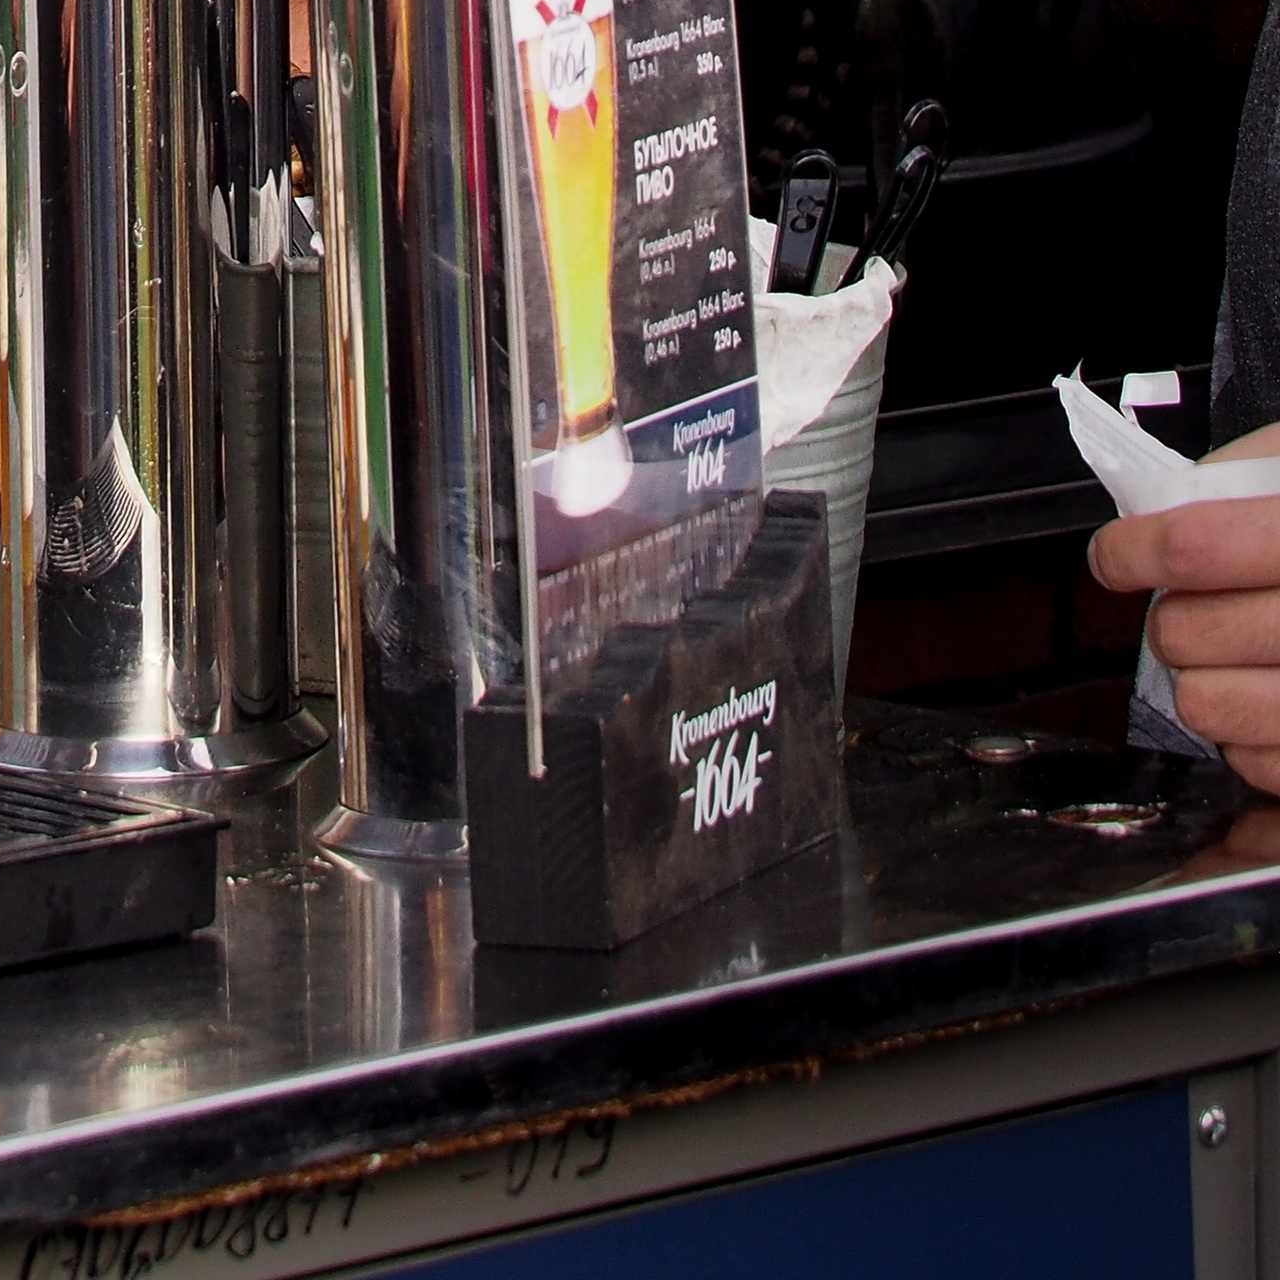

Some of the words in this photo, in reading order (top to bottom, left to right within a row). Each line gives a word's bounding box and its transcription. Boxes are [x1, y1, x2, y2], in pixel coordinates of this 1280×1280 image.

[625, 29, 680, 60] Kronenbourg
[680, 19, 702, 44] 1664
[702, 13, 725, 38] Blanc
[696, 51, 713, 76] 350
[633, 115, 718, 172] БУТЫЛОЧНОЕ
[636, 165, 674, 206] ПИВО
[638, 228, 693, 259] Kronenbourg
[693, 212, 716, 240] 1664
[709, 246, 727, 272] 250
[642, 308, 698, 342] Kronenbourg
[697, 293, 721, 321] 1664
[721, 288, 745, 315] Blanc
[714, 326, 732, 353] 250
[672, 407, 735, 454] Kronenbourg
[686, 436, 727, 494] 1664
[670, 679, 777, 765] Kronenbourg
[693, 728, 763, 833] 1664
